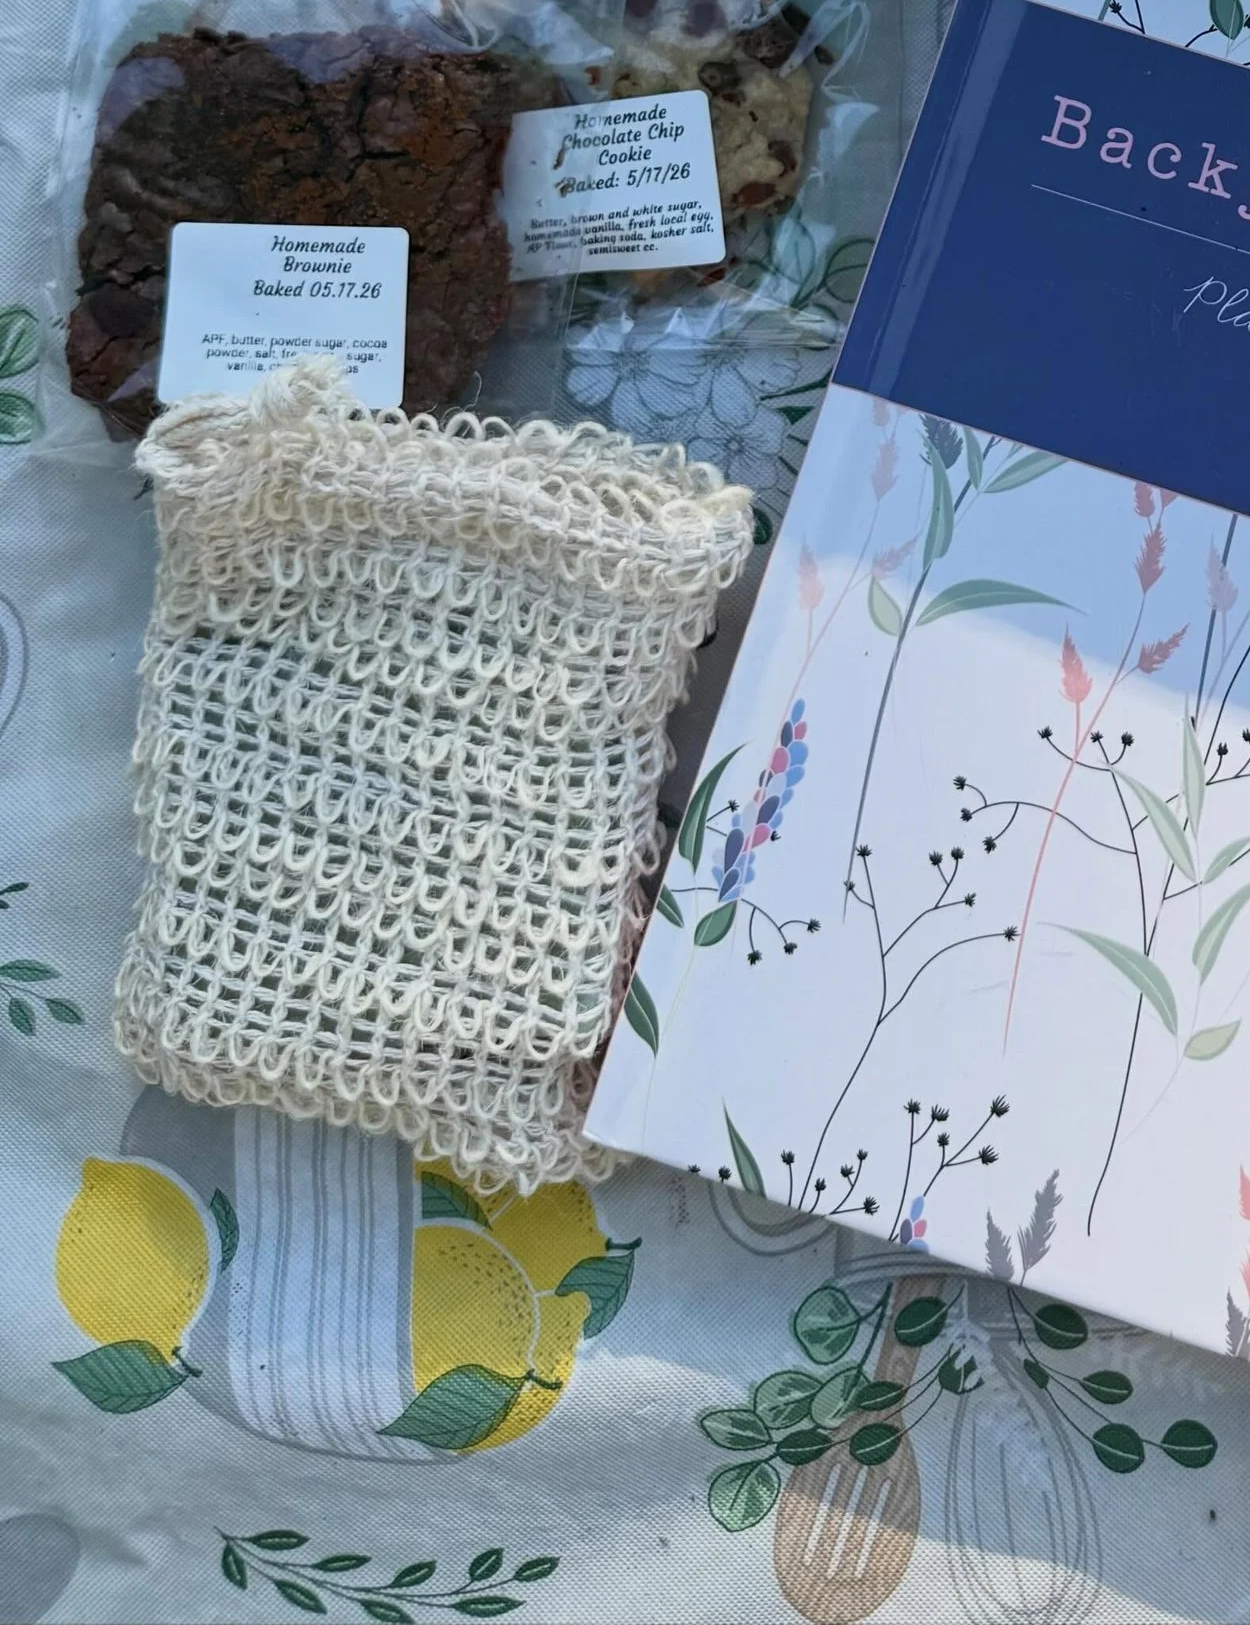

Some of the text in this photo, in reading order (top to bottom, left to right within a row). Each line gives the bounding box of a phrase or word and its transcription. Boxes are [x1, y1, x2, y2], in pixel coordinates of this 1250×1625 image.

[574, 103, 667, 131] Homemade
[561, 122, 685, 151] Chocolate Chip
[598, 147, 652, 166] Cookie
[565, 162, 691, 194] Baked: 5/17/26
[571, 213, 605, 224] brown
[608, 206, 629, 219] and
[633, 204, 663, 217] white
[667, 199, 702, 213] sugar,
[628, 217, 656, 231] fresh
[660, 212, 687, 225] local
[271, 235, 366, 254] Homemade
[581, 233, 616, 246] baking
[651, 227, 687, 239] kosher
[588, 243, 640, 256] semisweet
[282, 255, 352, 274] Brownie
[253, 278, 383, 299] Baked 05.17.26
[201, 334, 388, 350] APF, butter, powder sugar, cocoa
[206, 347, 252, 359] powder,
